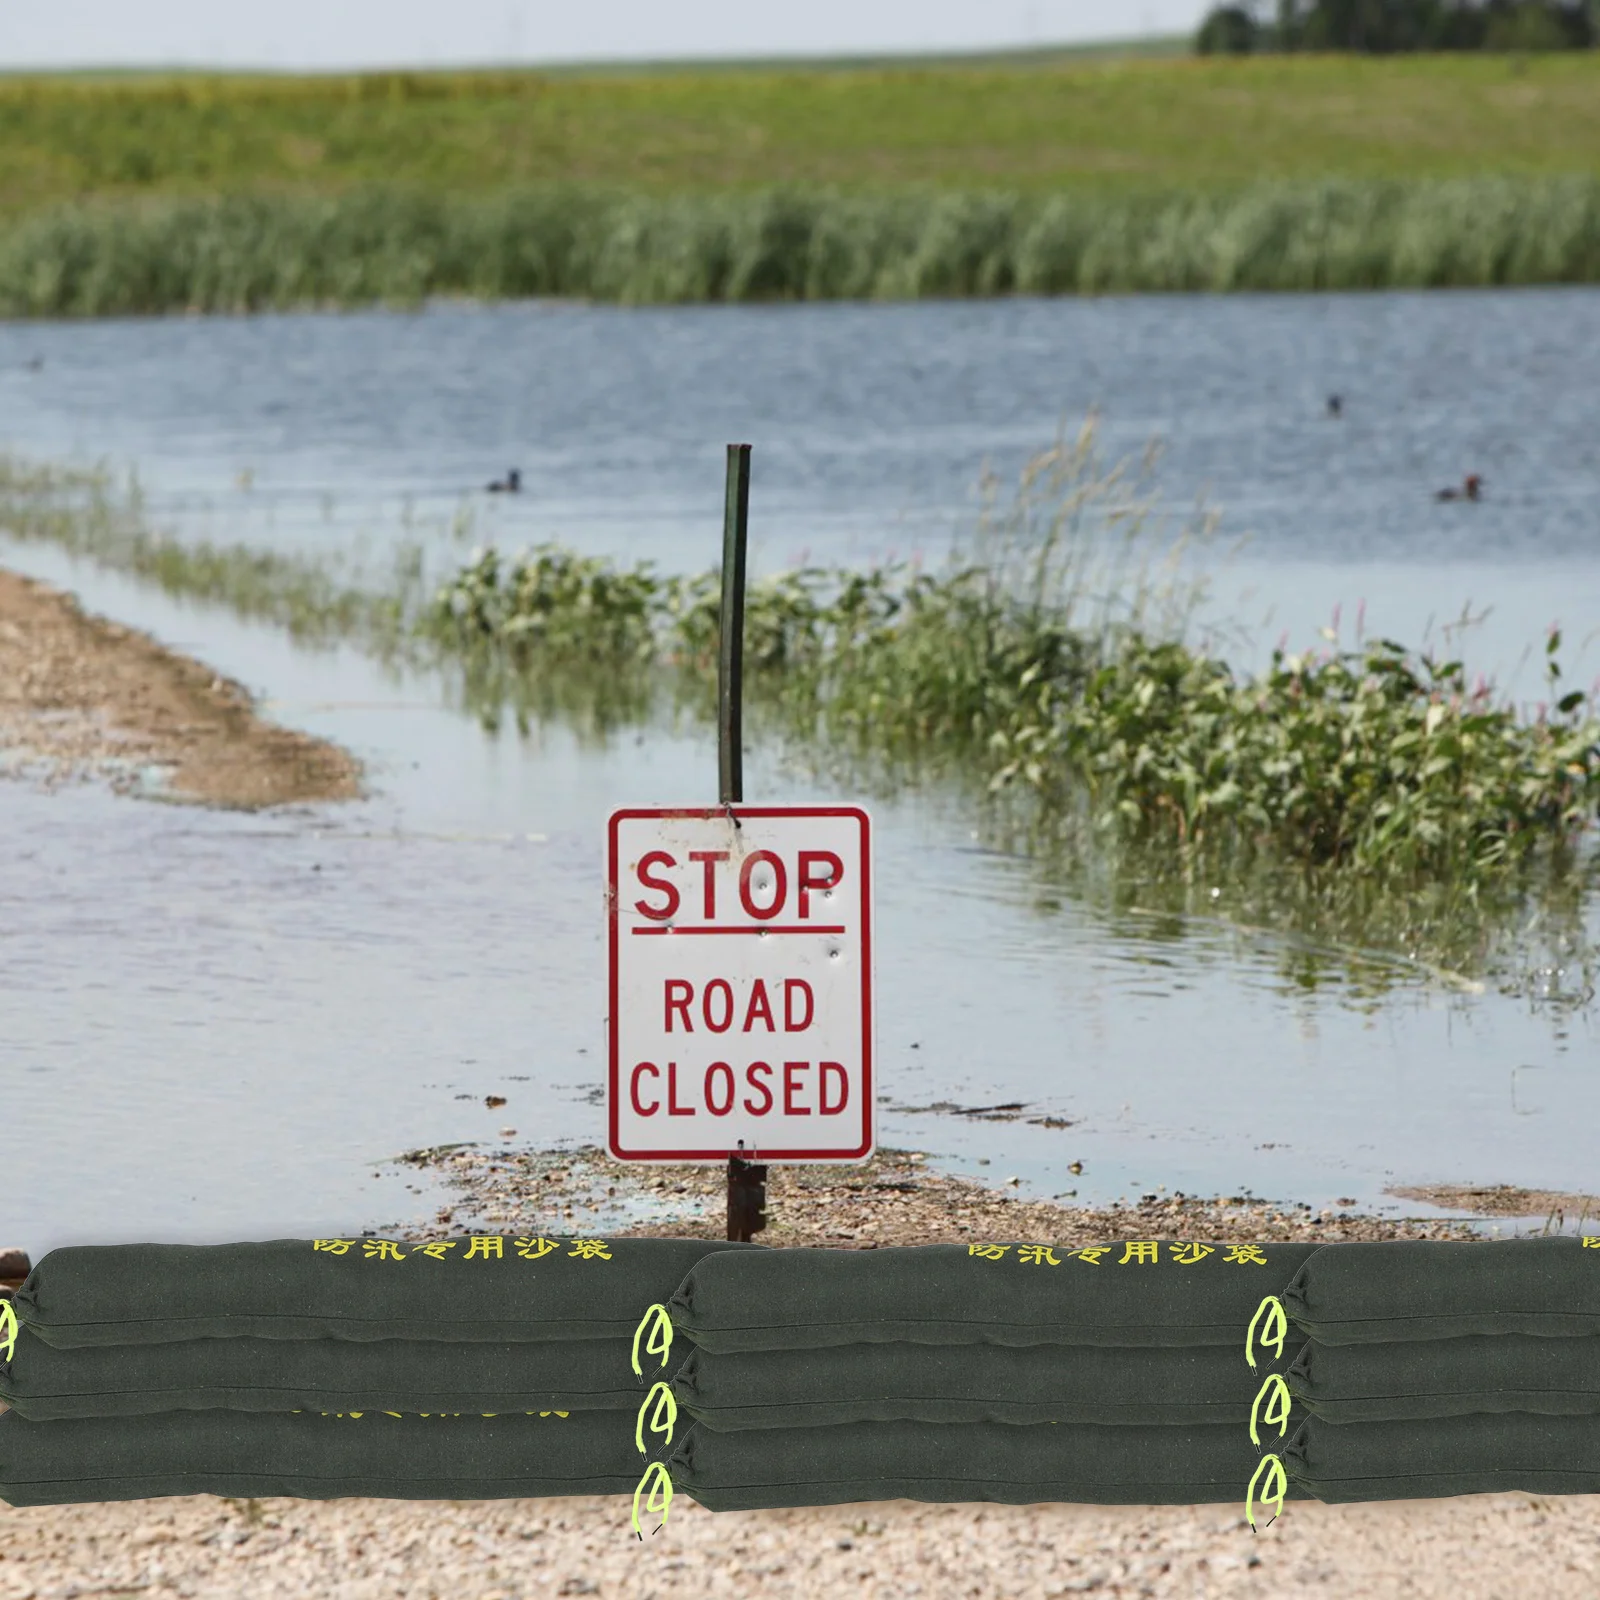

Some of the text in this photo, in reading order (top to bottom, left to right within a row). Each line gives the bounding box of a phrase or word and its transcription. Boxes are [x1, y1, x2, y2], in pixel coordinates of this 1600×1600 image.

[634, 850, 844, 920] STOP
[664, 978, 814, 1033] ROAD
[630, 1061, 849, 1117] CLOSED
